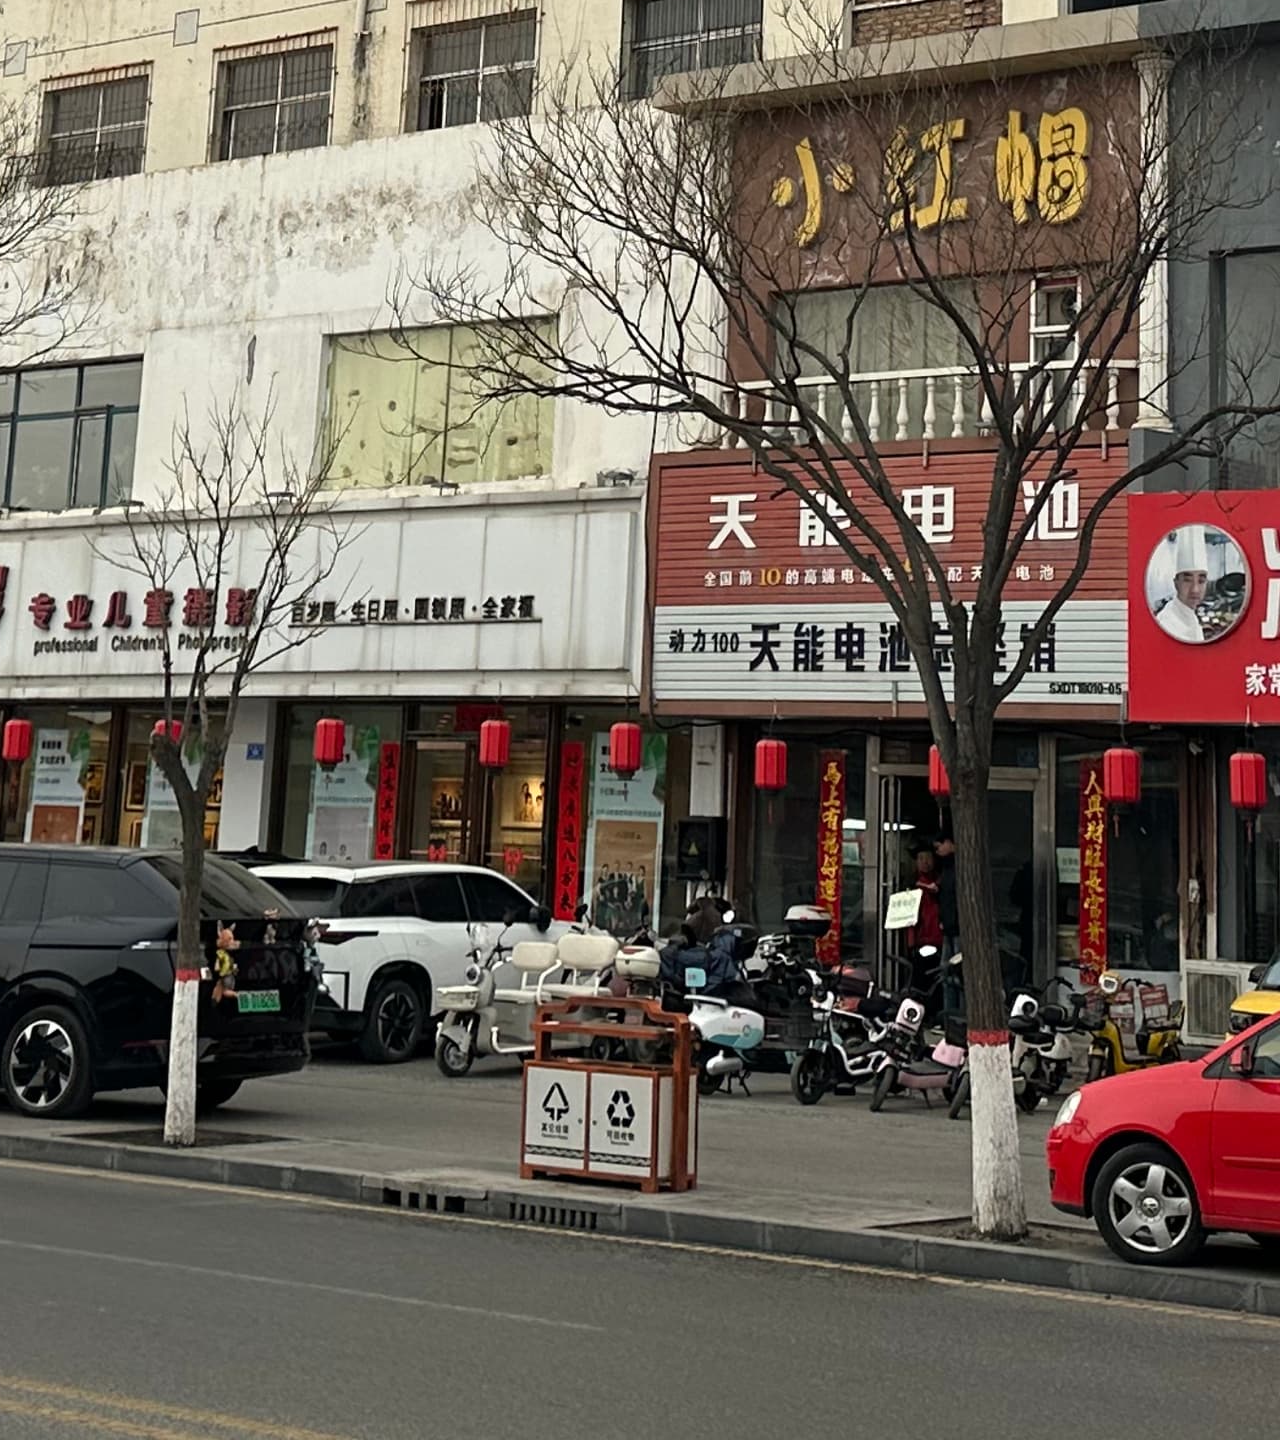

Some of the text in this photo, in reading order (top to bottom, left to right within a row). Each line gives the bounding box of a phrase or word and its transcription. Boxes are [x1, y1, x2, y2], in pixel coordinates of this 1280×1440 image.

[771, 106, 1092, 248] 小红帽
[707, 479, 1082, 551] 天能电池
[28, 587, 258, 631] 专业儿童摄影
[668, 627, 740, 654] 动力100
